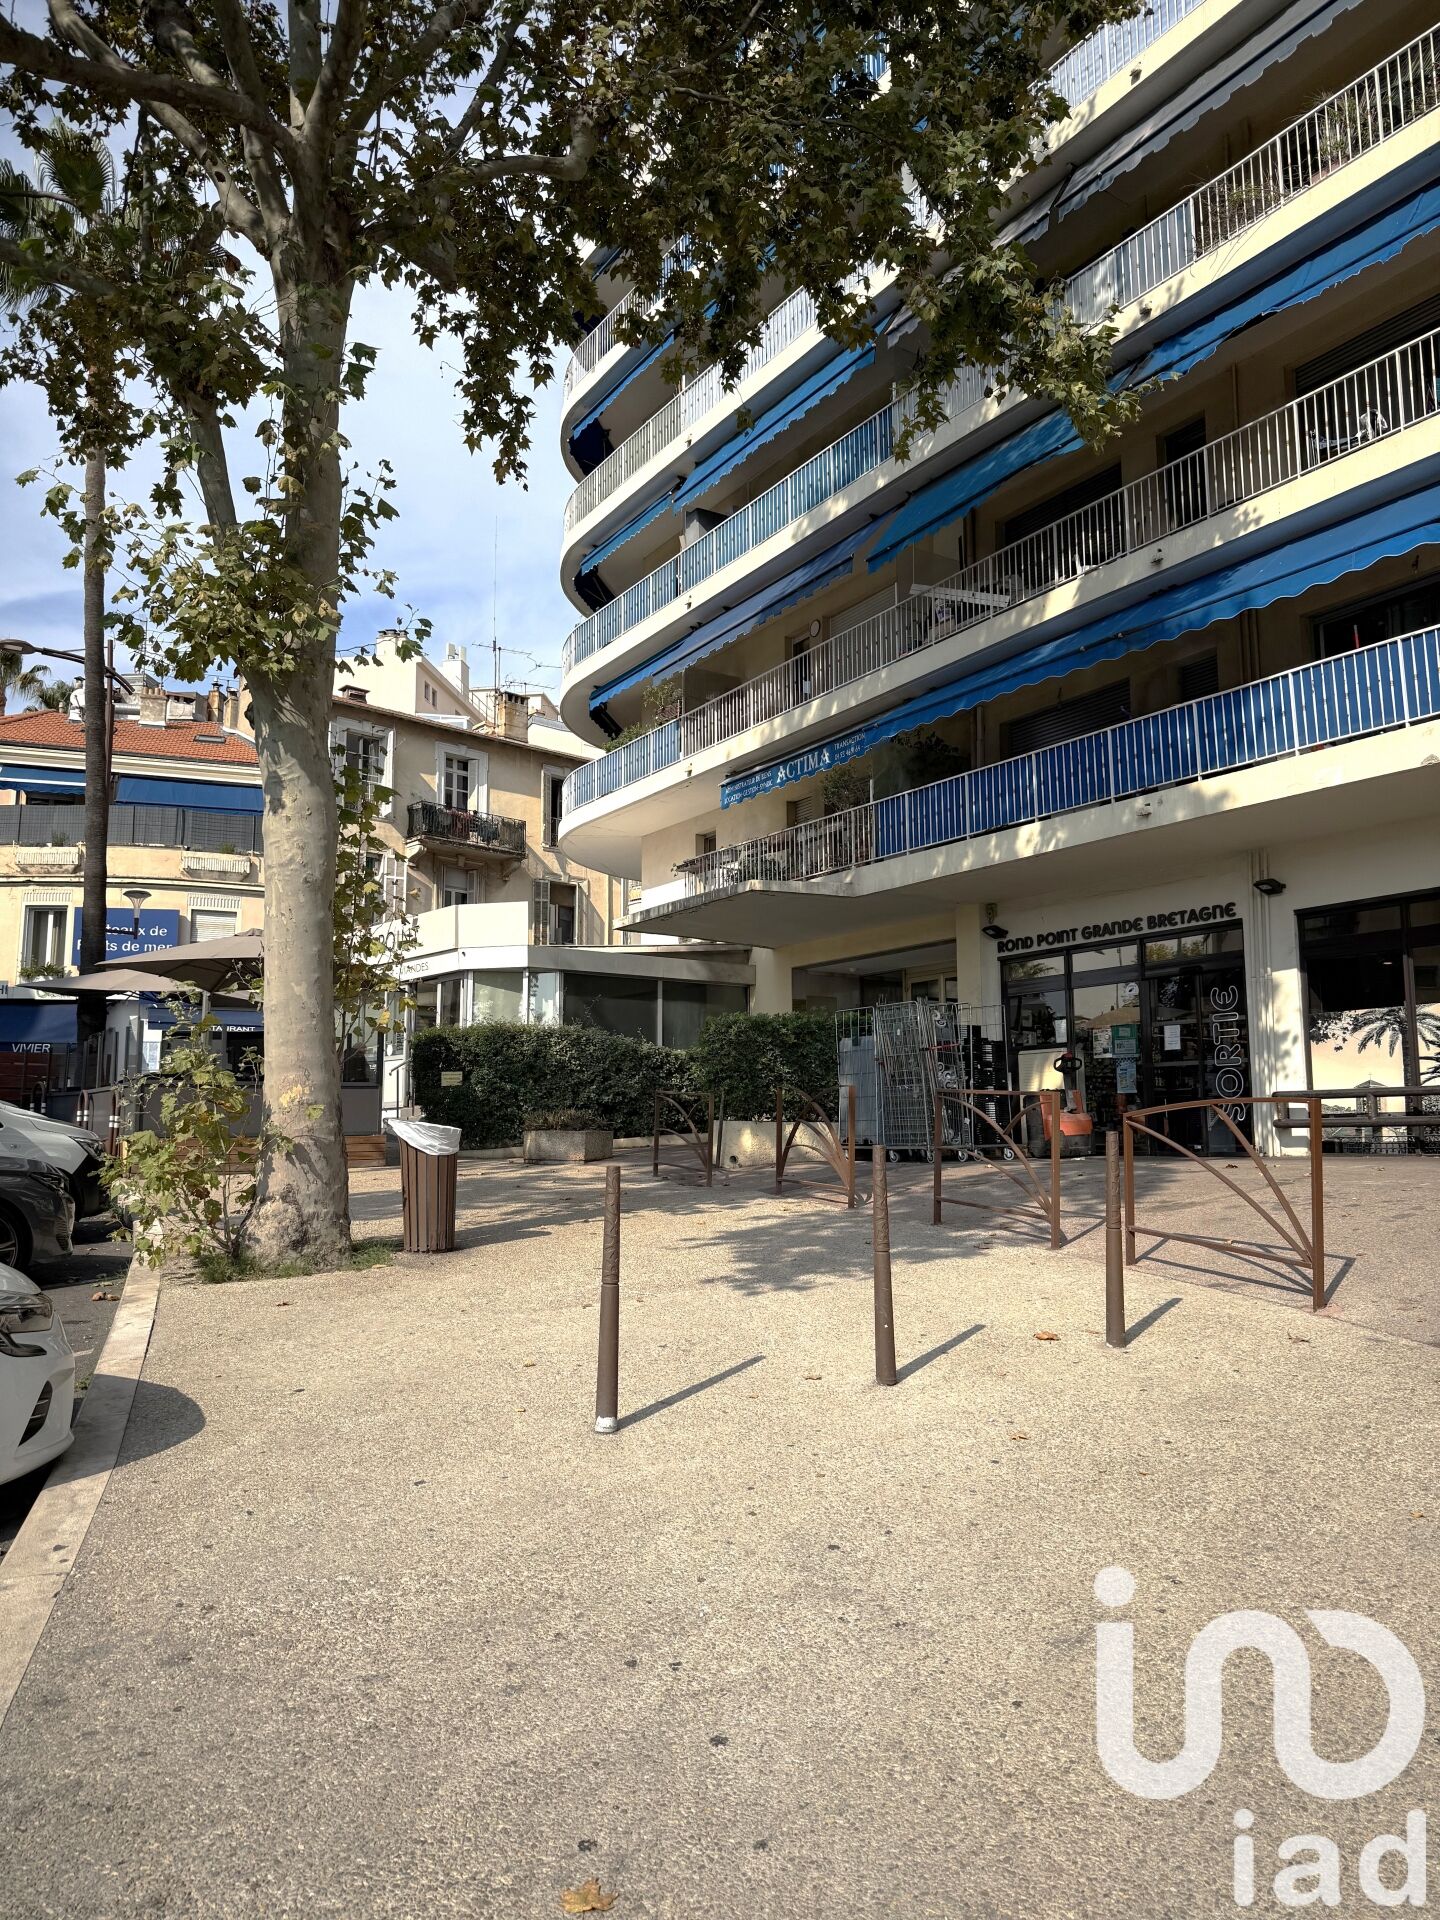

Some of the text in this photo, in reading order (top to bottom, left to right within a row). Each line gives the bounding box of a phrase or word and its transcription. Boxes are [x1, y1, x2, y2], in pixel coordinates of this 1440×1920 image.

[776, 747, 831, 784] ACTIMA
[149, 925, 168, 937] de
[997, 901, 1237, 954] ROND POINT GRANDE BRETAGNE
[121, 940, 140, 952] de
[11, 1043, 51, 1053] VIVIER
